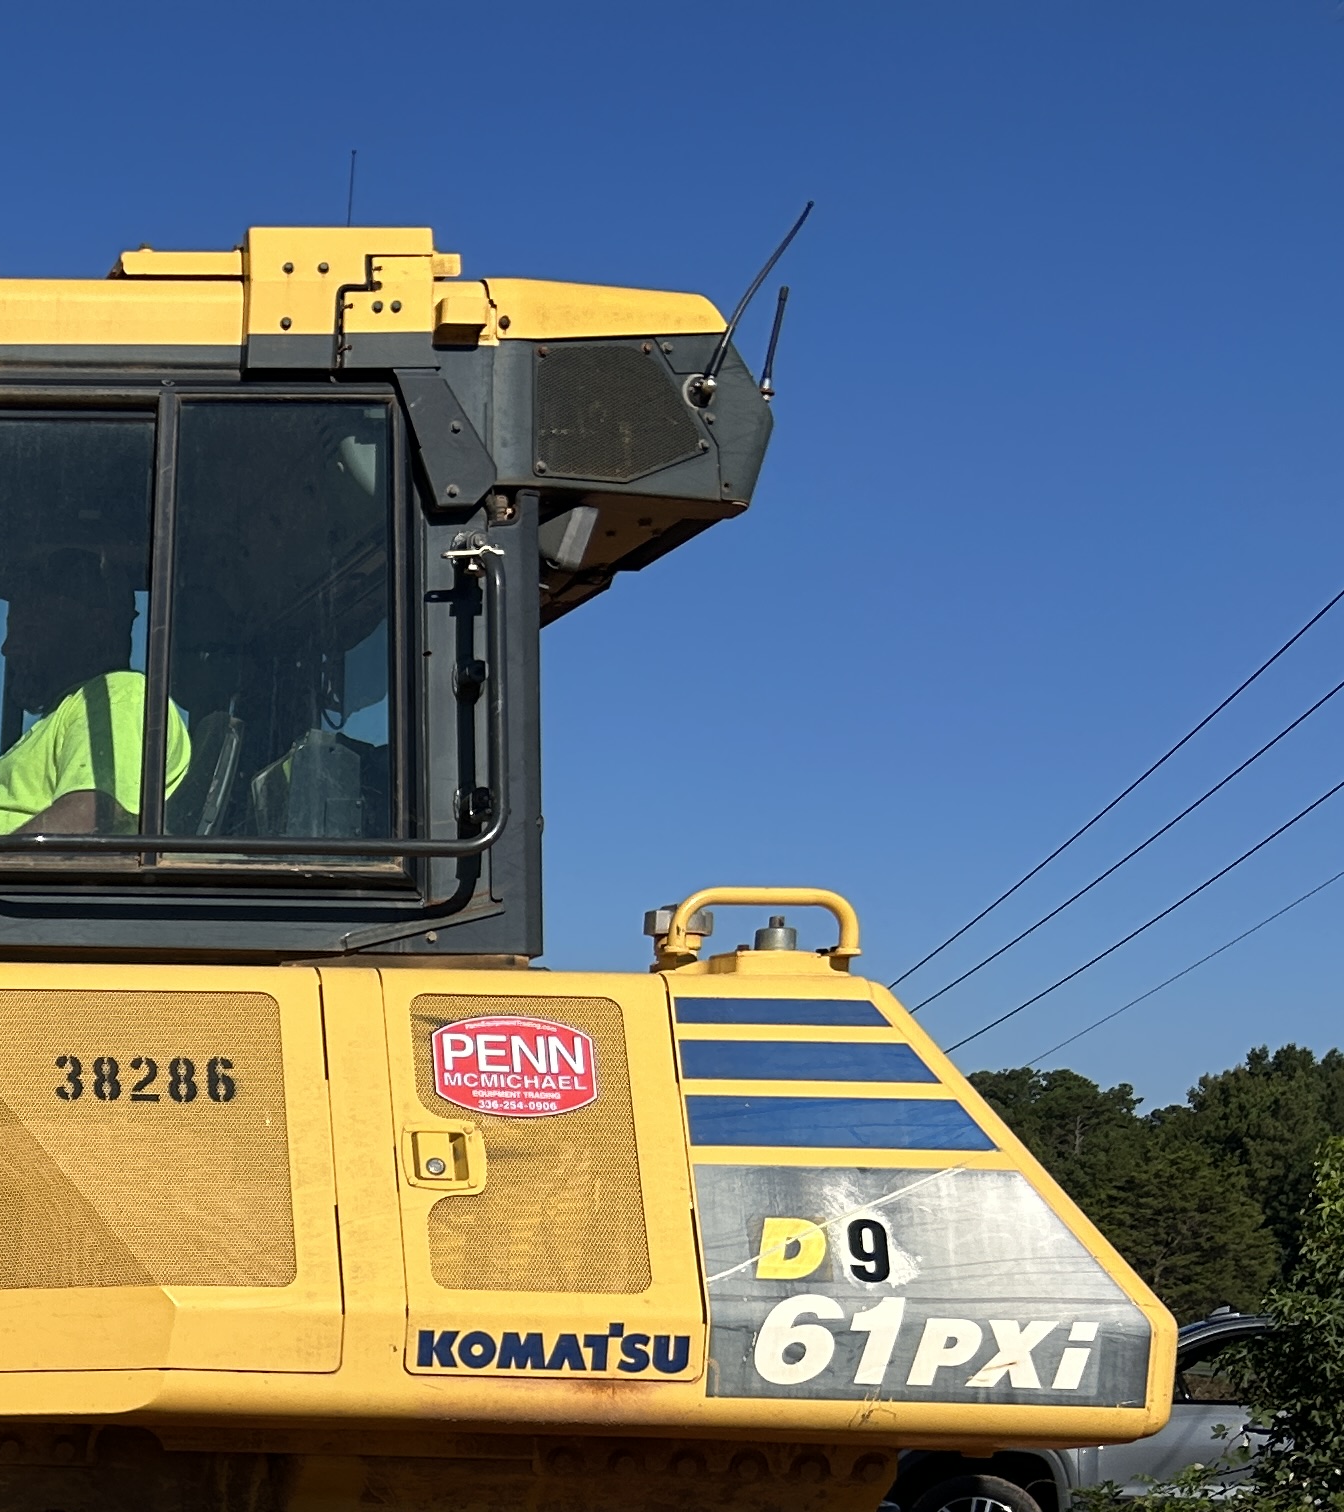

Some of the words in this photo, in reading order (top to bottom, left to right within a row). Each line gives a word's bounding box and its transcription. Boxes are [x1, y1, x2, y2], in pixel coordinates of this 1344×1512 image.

[442, 1034, 585, 1075] PENN
[55, 1055, 237, 1103] 38286
[444, 1072, 588, 1091] MCMICHAEL
[472, 1089, 521, 1099] EQUIPMENT
[523, 1091, 561, 1100] TRADING
[478, 1100, 558, 1111] 336-254-0906
[755, 1217, 826, 1280] D
[847, 1218, 890, 1283] 9
[416, 1322, 691, 1375] KOMATSU
